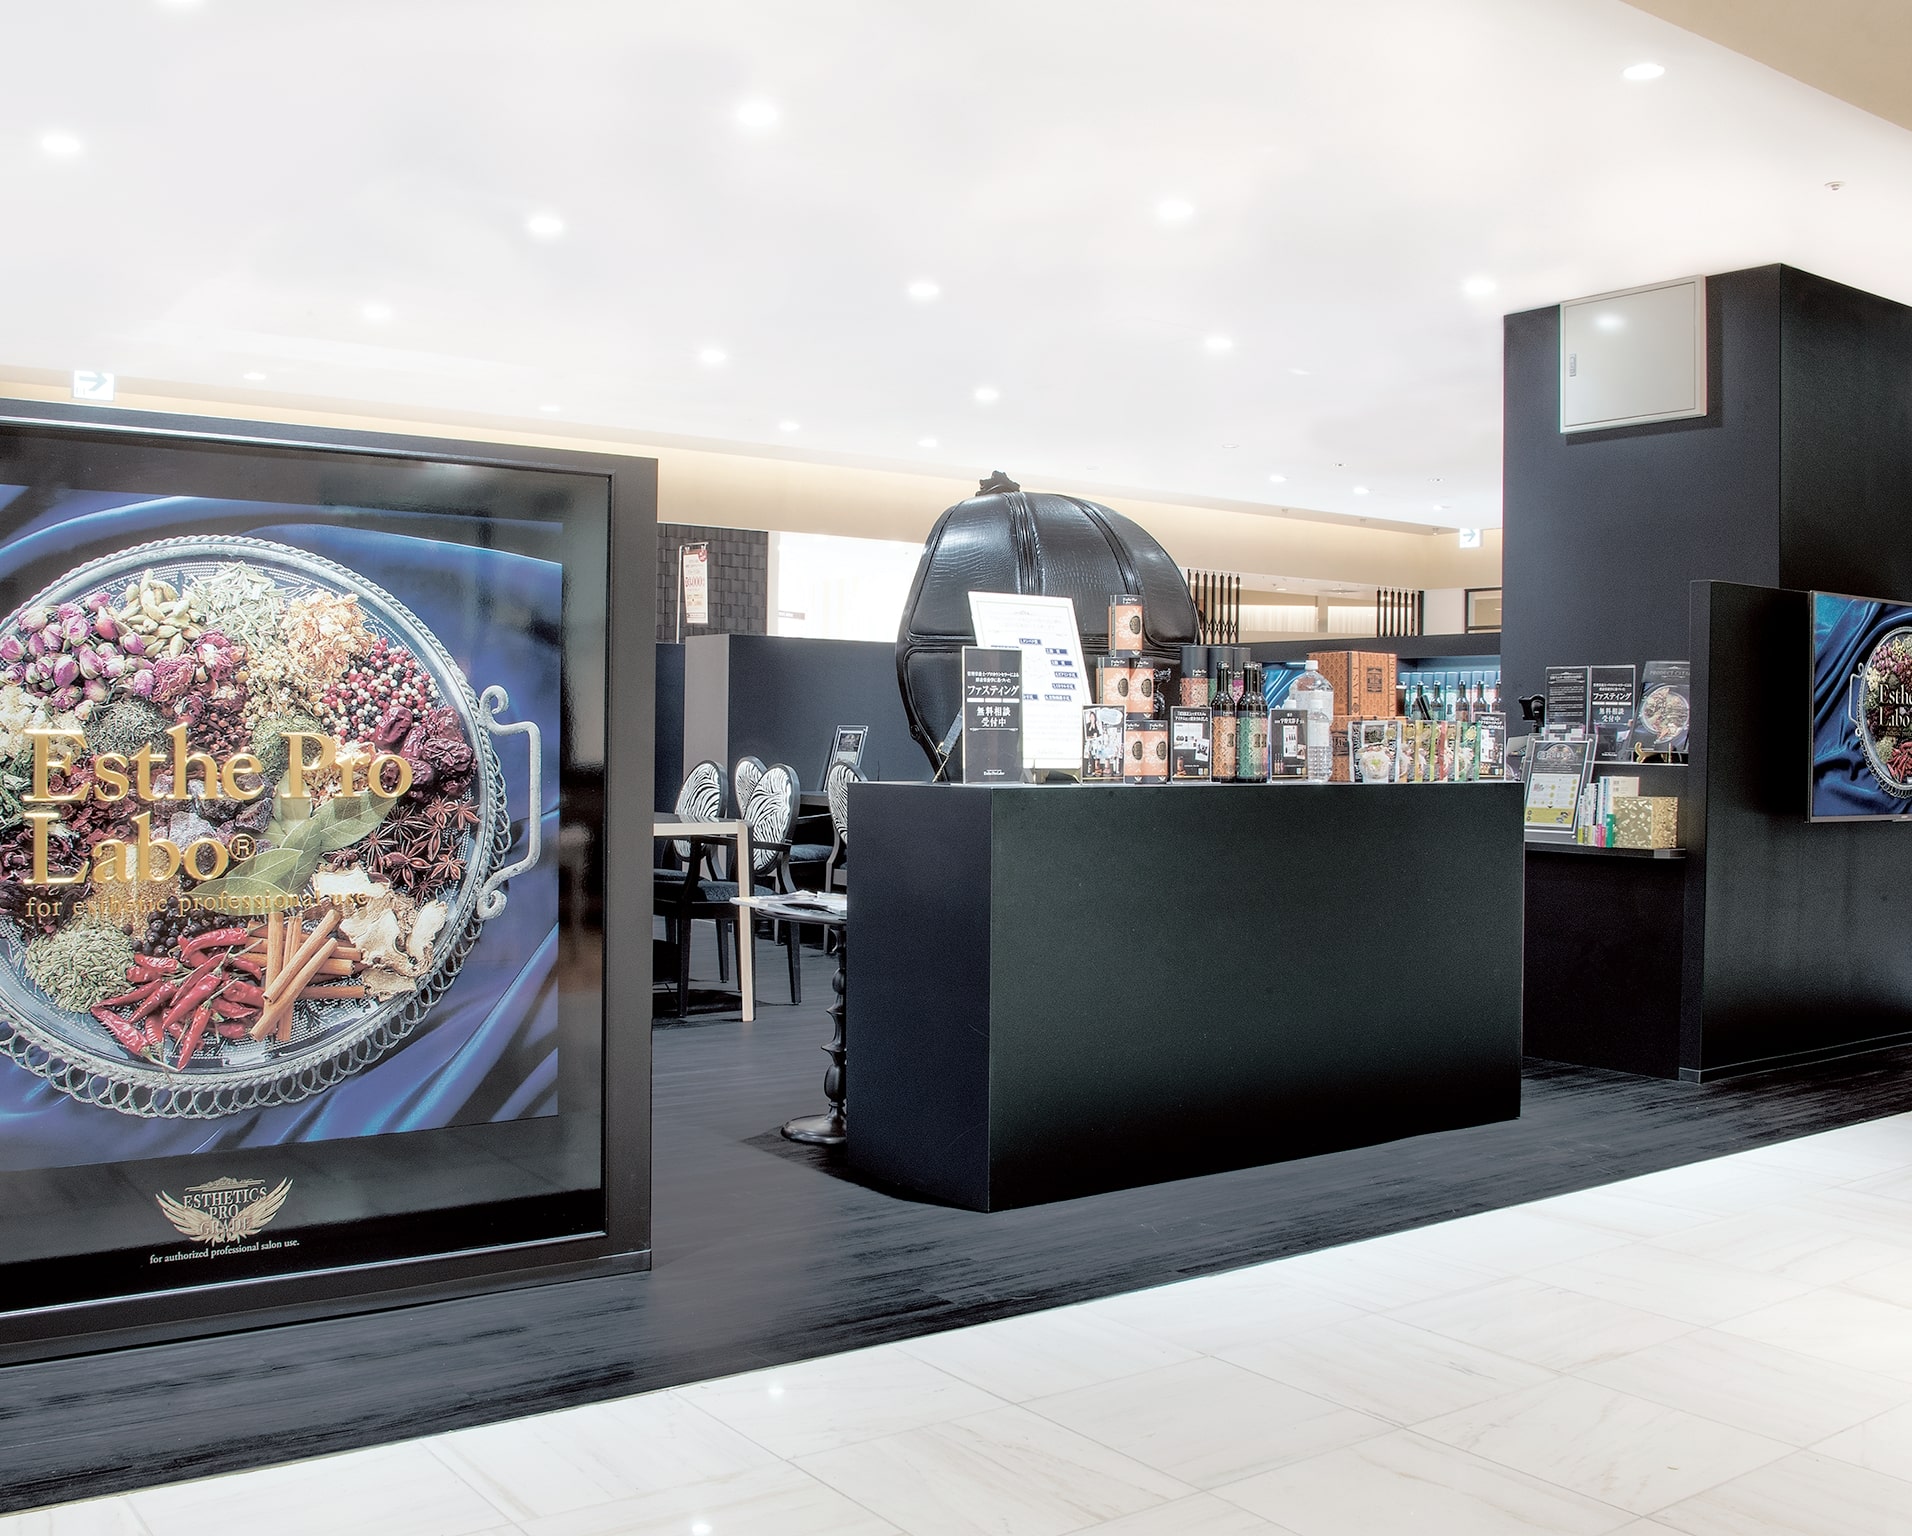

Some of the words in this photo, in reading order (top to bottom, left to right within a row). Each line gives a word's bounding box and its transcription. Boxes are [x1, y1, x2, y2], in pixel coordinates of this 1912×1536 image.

[967, 685, 1020, 697] ファスティング
[1592, 692, 1632, 701] ファスティング
[976, 706, 1011, 717] 無料相談
[1879, 705, 1910, 728] Labo
[981, 717, 1007, 727] 受付中
[22, 721, 265, 802] Esthe
[281, 732, 413, 799] Pro
[25, 897, 62, 917] for
[73, 895, 169, 915] esthetic
[179, 889, 323, 919] professional
[333, 890, 370, 905] use
[183, 1186, 268, 1210] ESTHETICS
[199, 1217, 252, 1235] GRADE
[150, 1254, 163, 1264] for
[164, 1248, 209, 1263] authorized
[210, 1242, 260, 1259] professional
[261, 1240, 283, 1250] salon
[284, 1239, 300, 1248] use.
